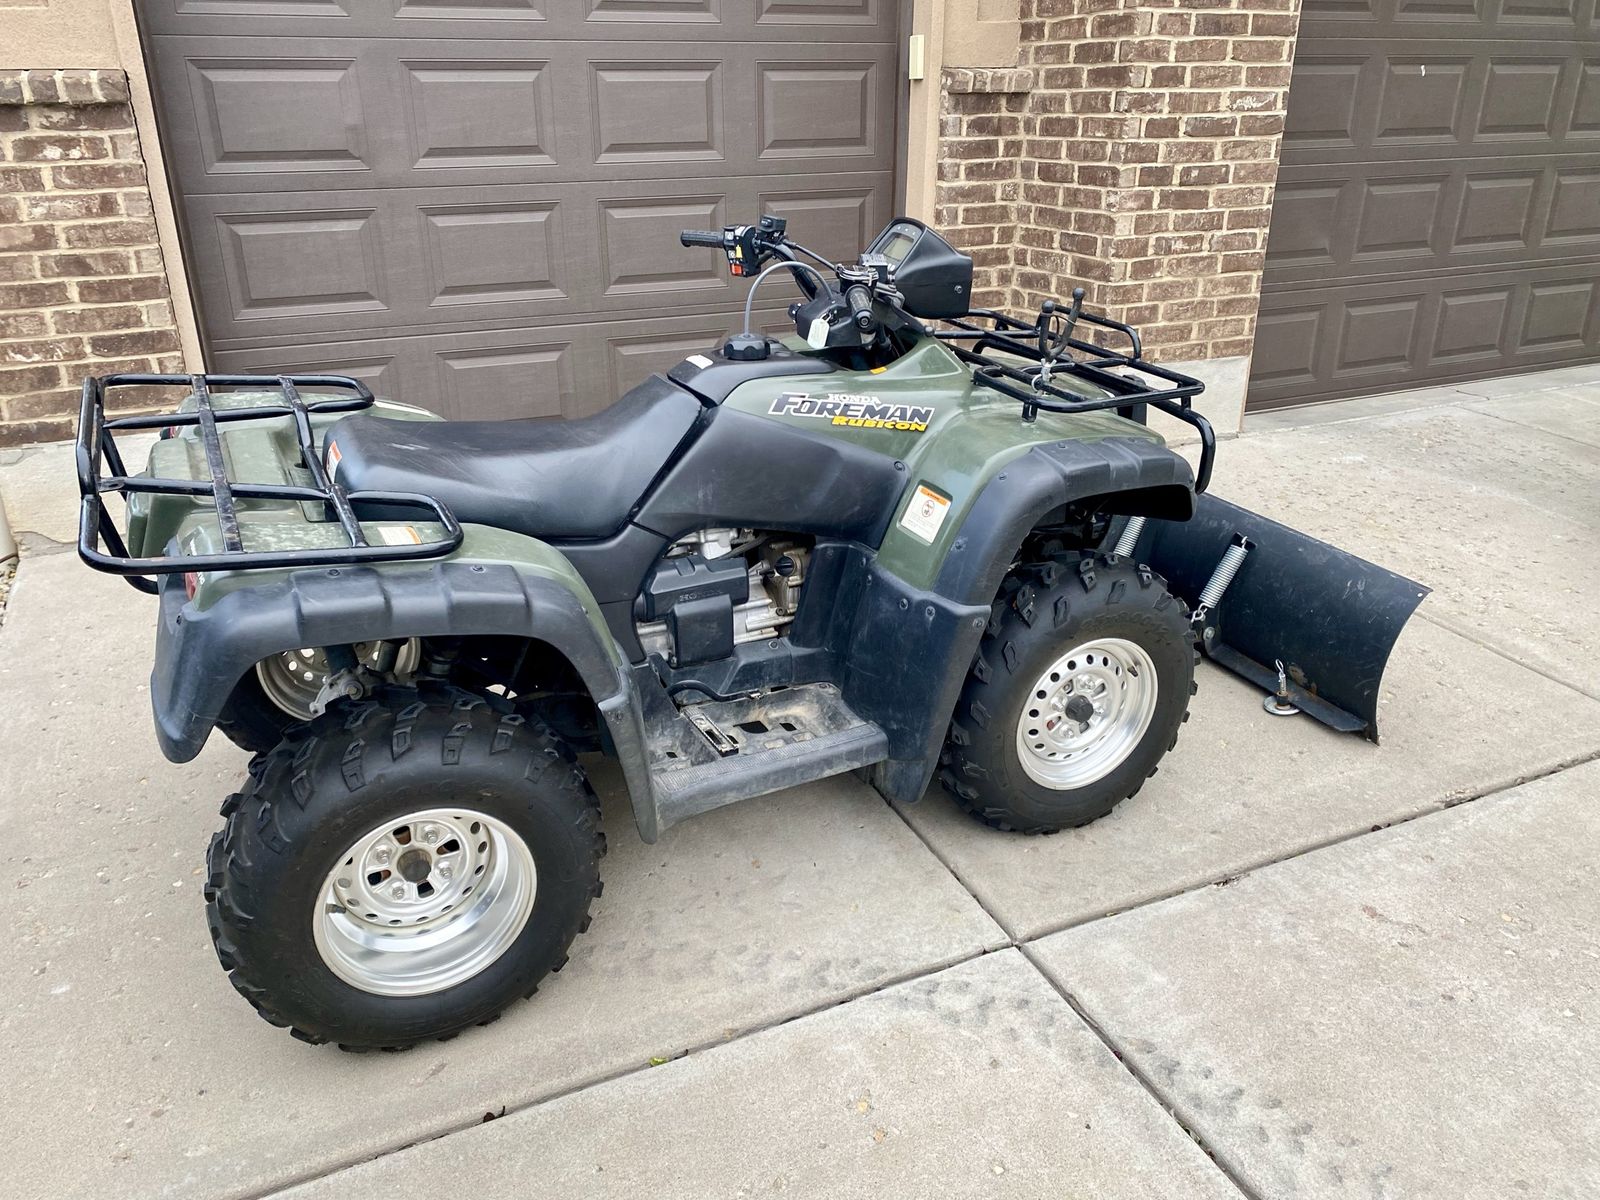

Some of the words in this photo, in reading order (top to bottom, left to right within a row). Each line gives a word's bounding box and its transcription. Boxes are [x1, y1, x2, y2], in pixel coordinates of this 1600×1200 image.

[827, 393, 881, 404] HONDA
[768, 392, 936, 424] FOREMAN
[831, 416, 928, 432] RUBICON
